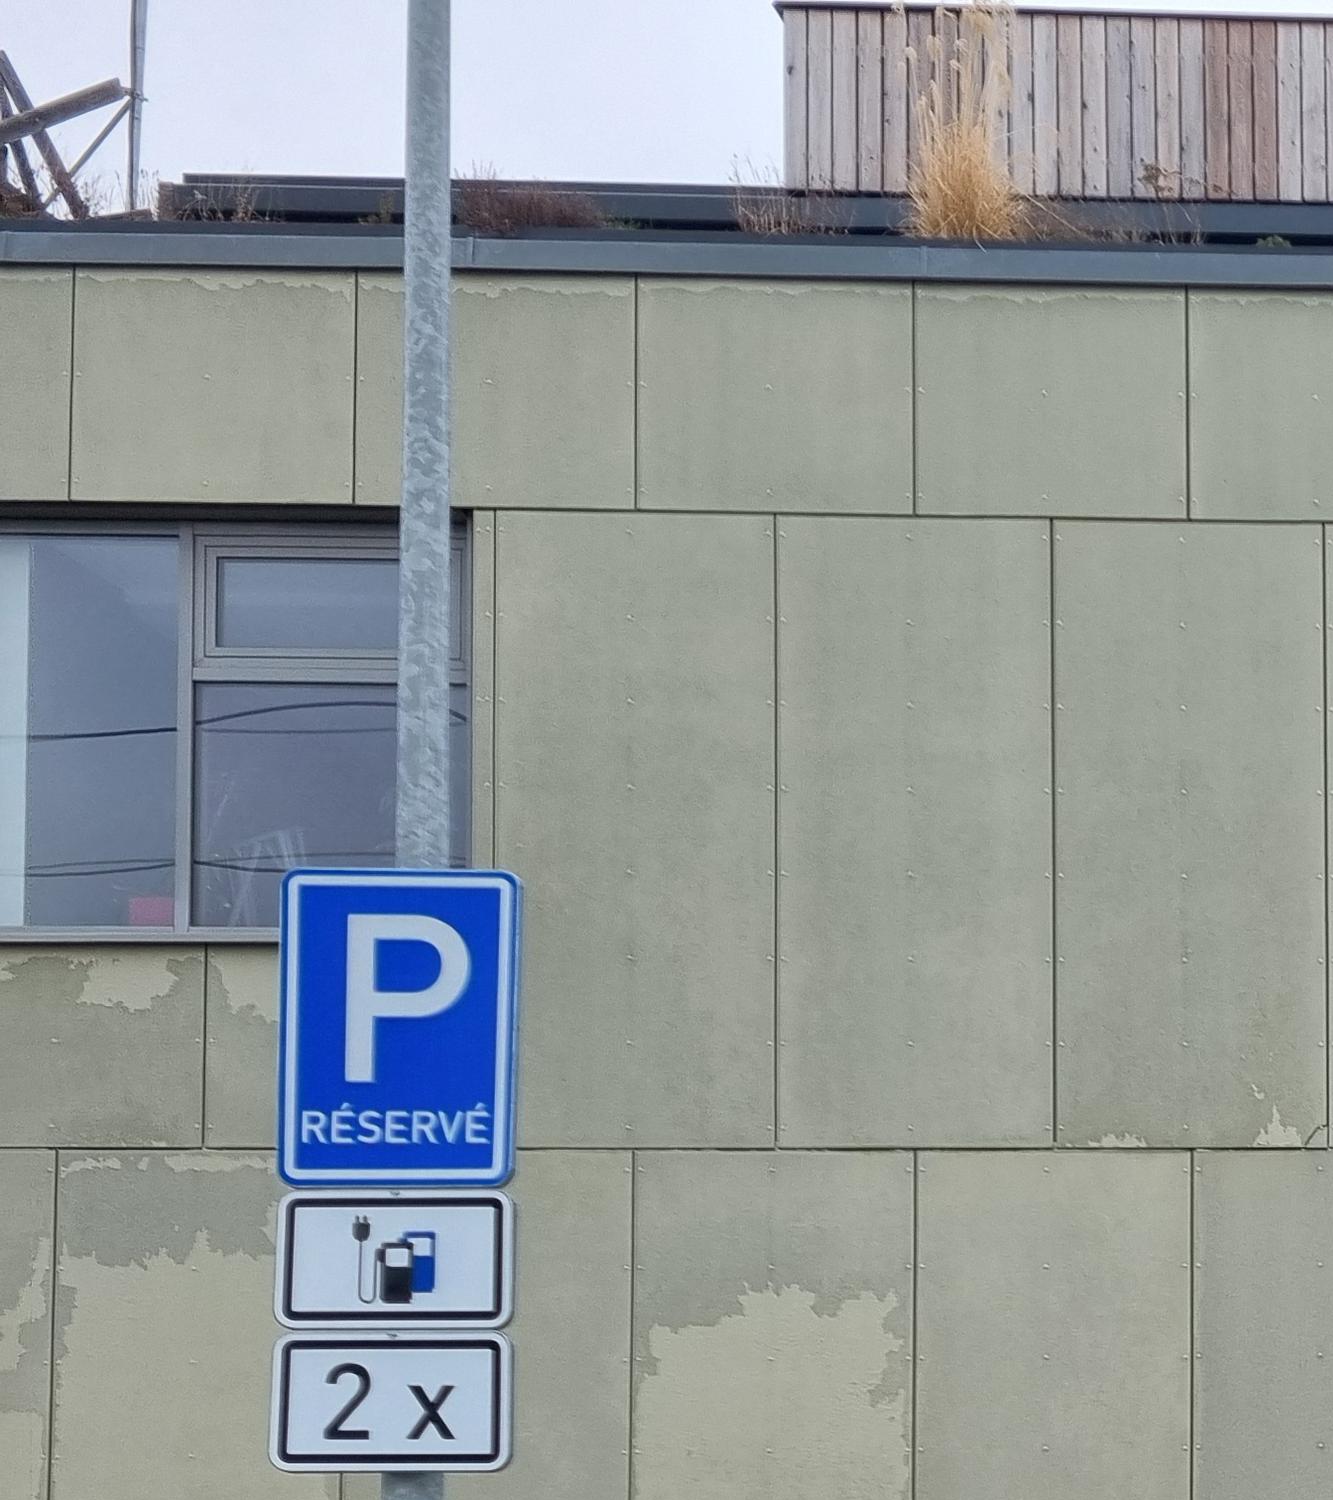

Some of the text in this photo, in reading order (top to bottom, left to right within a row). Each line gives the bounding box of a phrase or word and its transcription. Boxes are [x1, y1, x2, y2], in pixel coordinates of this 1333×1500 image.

[345, 913, 472, 1083] P
[301, 1102, 492, 1145] RÉSERVÉ
[323, 1362, 457, 1440] 2 x
